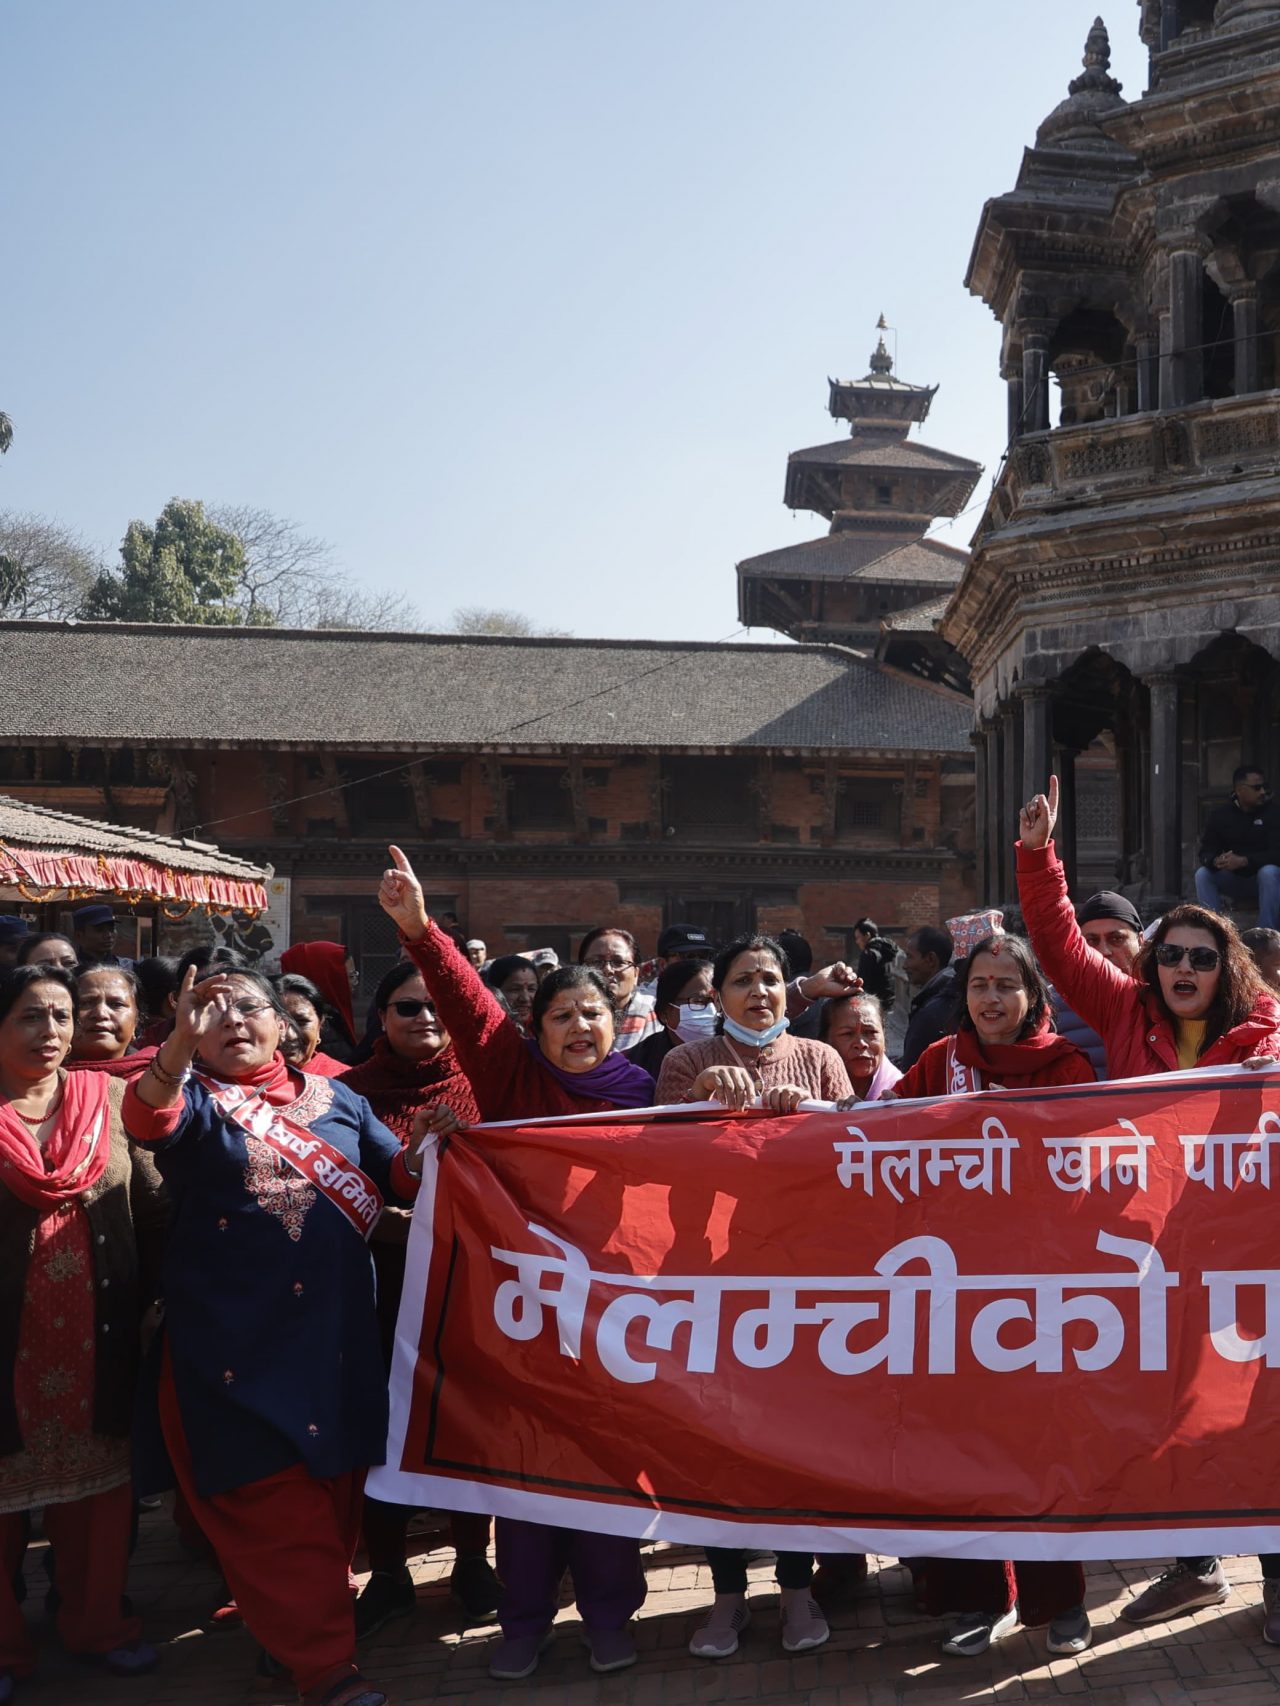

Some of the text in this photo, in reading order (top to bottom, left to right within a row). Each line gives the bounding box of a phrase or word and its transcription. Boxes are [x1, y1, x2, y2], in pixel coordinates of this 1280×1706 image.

[313, 1154, 379, 1224] समिति
[832, 1116, 1020, 1203] मेलम्ची
[1042, 1118, 1155, 1193] खाने
[491, 1222, 1179, 1383] मेलम्चीको
